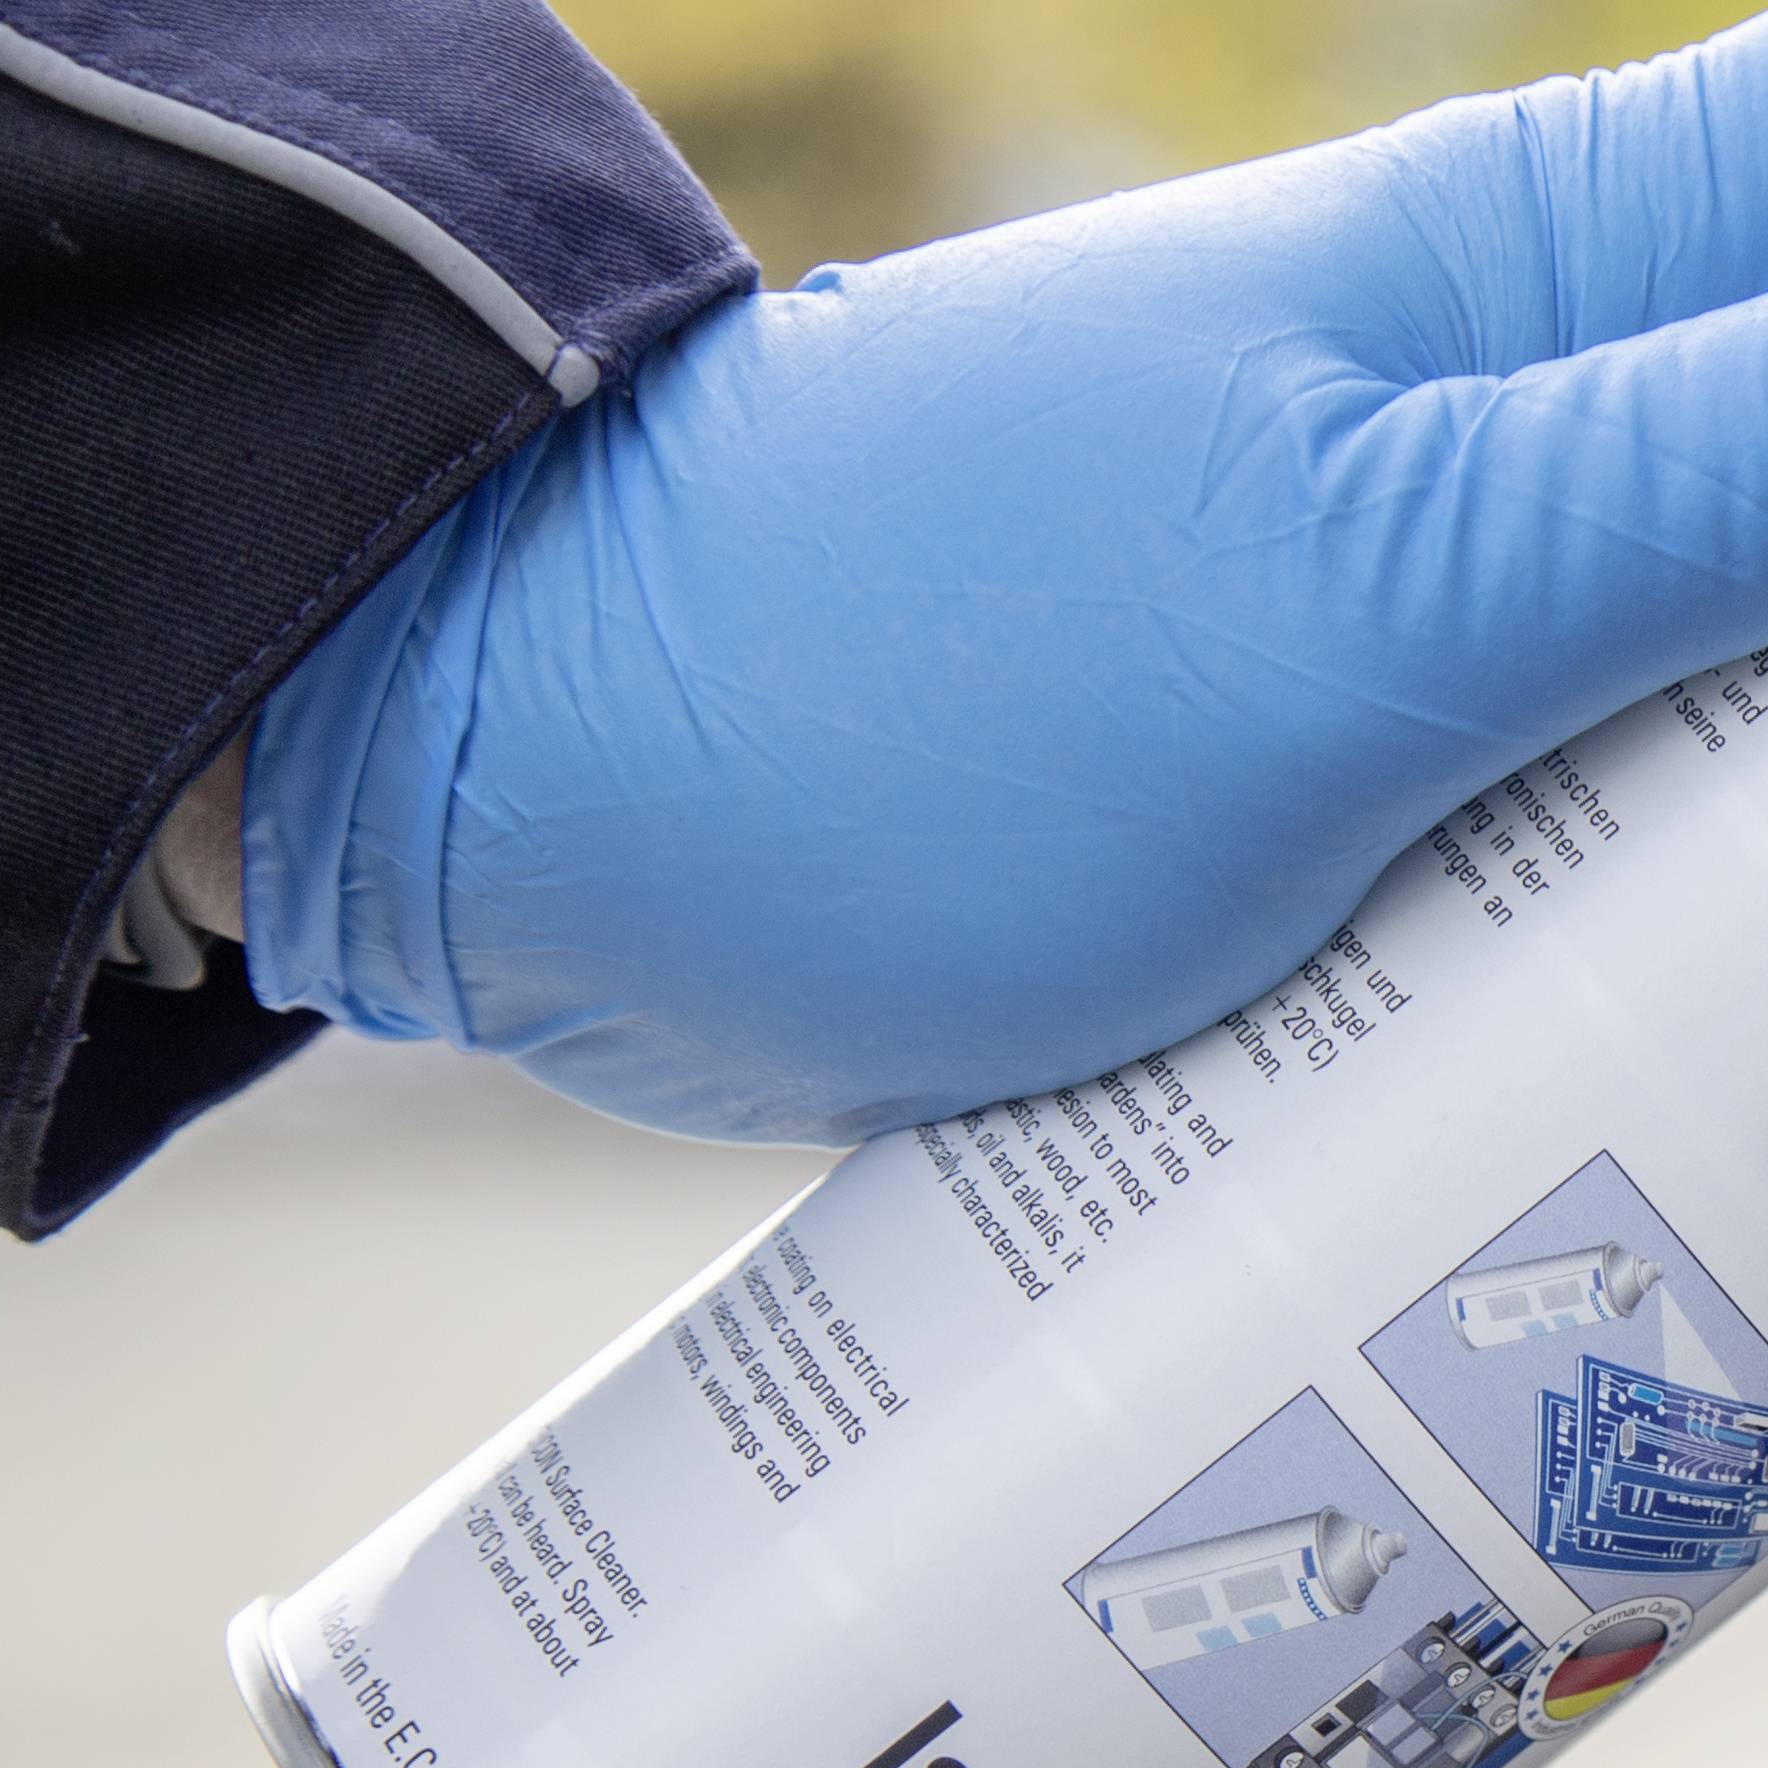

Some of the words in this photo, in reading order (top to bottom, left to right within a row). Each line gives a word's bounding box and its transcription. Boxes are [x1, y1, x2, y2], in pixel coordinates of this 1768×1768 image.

[1675, 696, 1727, 753] seine
[1497, 767, 1585, 870] ronischen
[1535, 743, 1620, 841] trischen
[1416, 820, 1487, 896] rungen
[1483, 895, 1513, 928] an
[1489, 825, 1515, 857] in
[1512, 858, 1551, 896] der
[1296, 955, 1377, 1043] schkugel
[1323, 915, 1372, 970] igen
[1366, 969, 1413, 1014] und
[1215, 1007, 1282, 1084] prühen.
[975, 1132, 1006, 1157] oil
[988, 1151, 1028, 1189] and
[996, 1094, 1042, 1143] astic,
[1035, 1137, 1089, 1202] wood,
[1079, 1199, 1114, 1244] etc.
[1089, 1132, 1114, 1160] to
[1106, 1157, 1158, 1217] most
[1150, 1135, 1190, 1185] into
[1187, 1113, 1234, 1158] and
[951, 1177, 1054, 1302] characterized
[1011, 1184, 1065, 1256] alkalis,
[1060, 1245, 1086, 1274] it
[741, 1265, 791, 1333] electronic
[777, 1327, 867, 1445] components
[777, 1236, 817, 1296] coating
[807, 1290, 834, 1319] on
[826, 1319, 910, 1418] electrical
[674, 1323, 709, 1381] motors,
[700, 1374, 764, 1460] windings
[756, 1459, 802, 1504] and
[709, 1300, 764, 1368] electrical
[745, 1362, 832, 1479] engineering
[497, 1475, 524, 1507] can
[510, 1495, 535, 1528] be
[523, 1518, 574, 1585] heard.
[545, 1465, 594, 1537] Surface
[584, 1530, 648, 1619] Cleaner.
[489, 1555, 529, 1595] and
[511, 1590, 539, 1618] at
[526, 1612, 580, 1678] about
[561, 1578, 614, 1648] Spray
[339, 1647, 371, 1686] in
[356, 1678, 395, 1729] the
